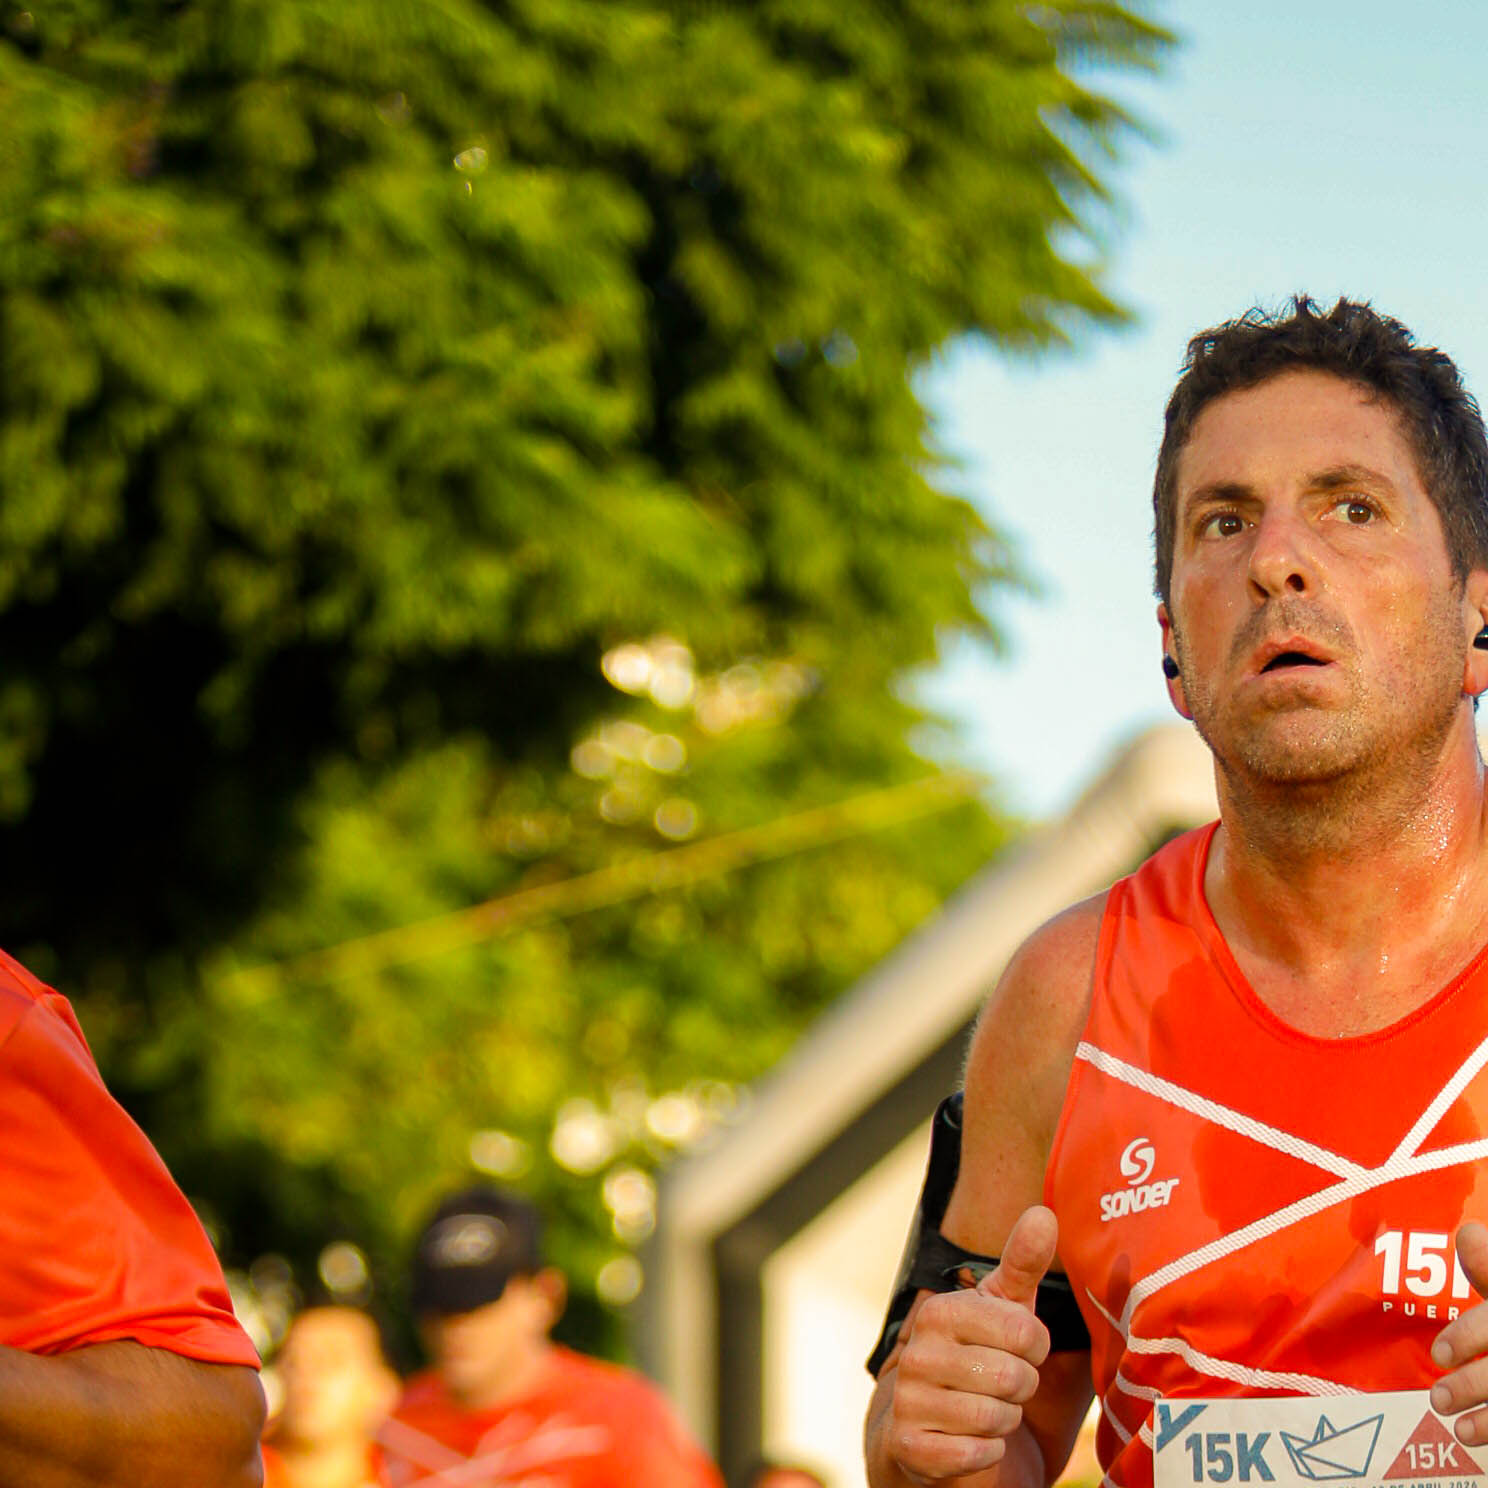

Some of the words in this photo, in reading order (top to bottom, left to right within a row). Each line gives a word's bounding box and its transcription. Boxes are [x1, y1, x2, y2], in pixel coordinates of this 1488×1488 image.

[1382, 1301, 1460, 1321] PUER
[1185, 1432, 1276, 1483] 15K
[1405, 1441, 1459, 1470] 15K
